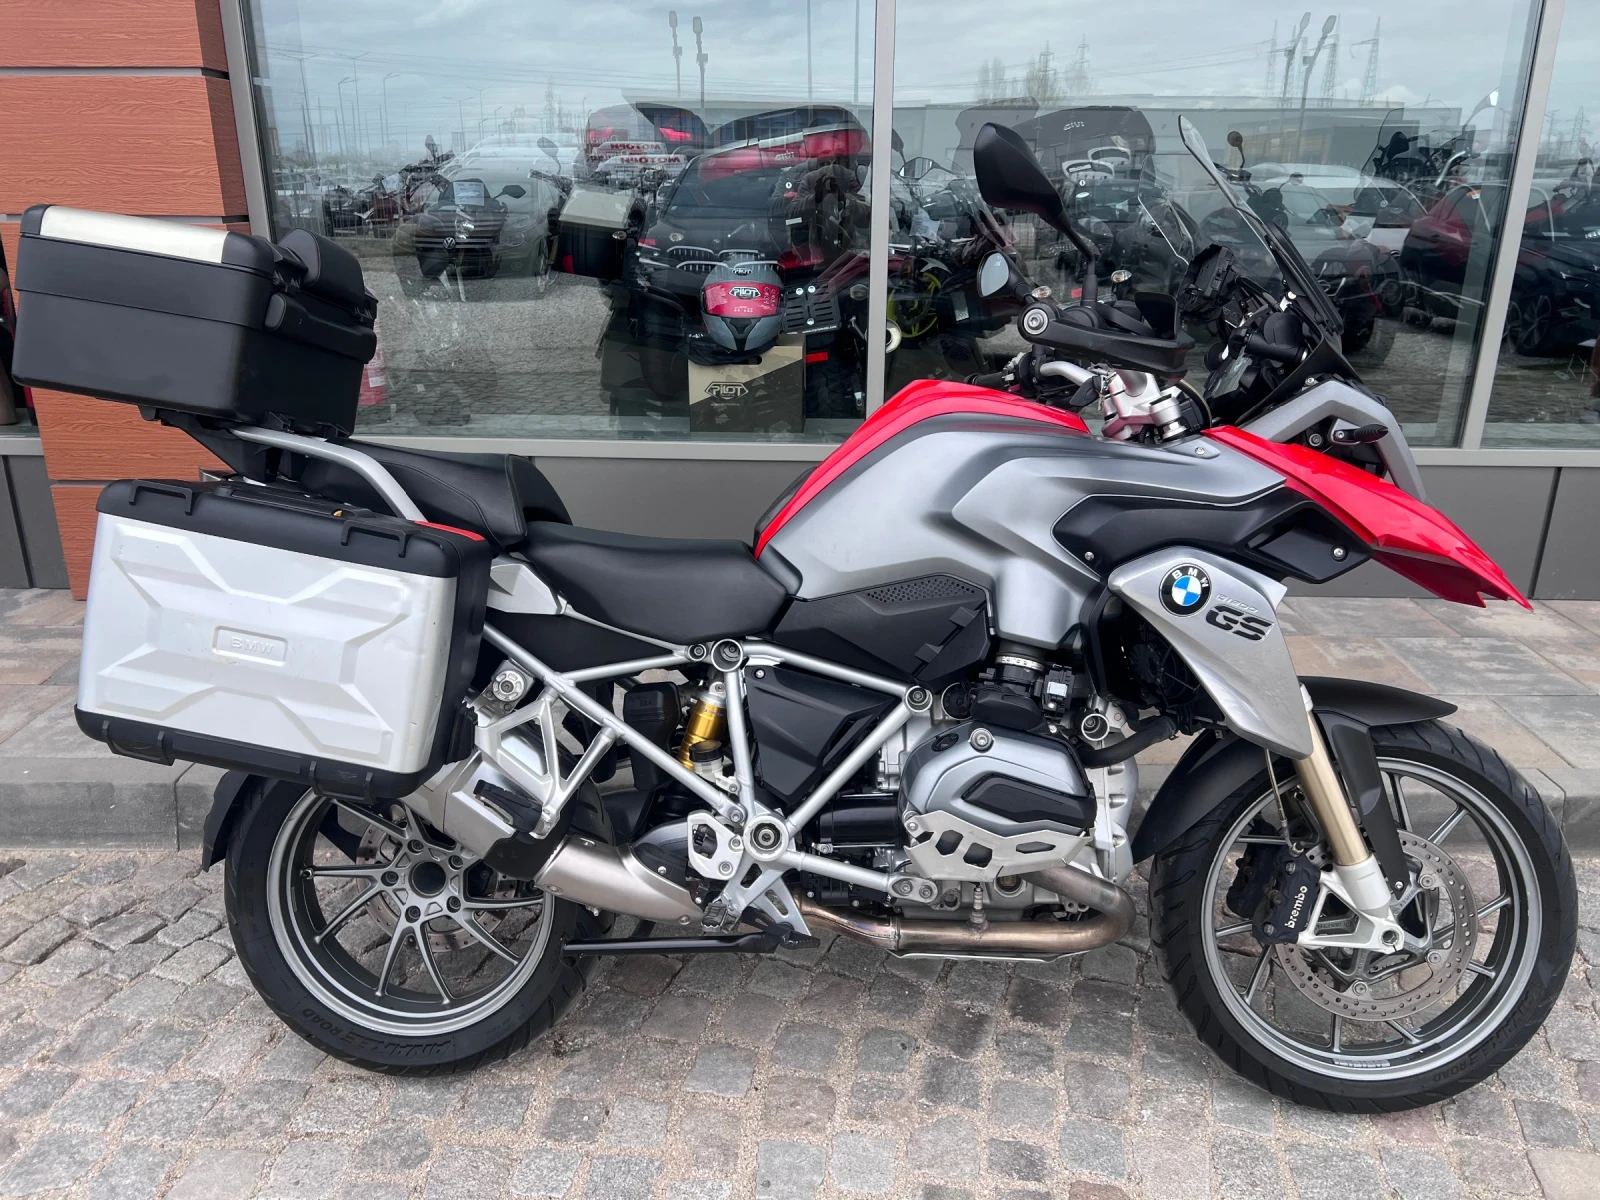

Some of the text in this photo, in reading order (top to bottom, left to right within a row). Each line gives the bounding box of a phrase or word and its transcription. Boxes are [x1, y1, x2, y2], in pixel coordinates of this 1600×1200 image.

[1171, 567, 1209, 588] BMW
[1205, 604, 1273, 641] GS
[230, 635, 274, 655] BMW
[1284, 885, 1308, 929] brembo
[301, 1007, 345, 1037] ROAD
[1432, 1060, 1469, 1083] ROAD
